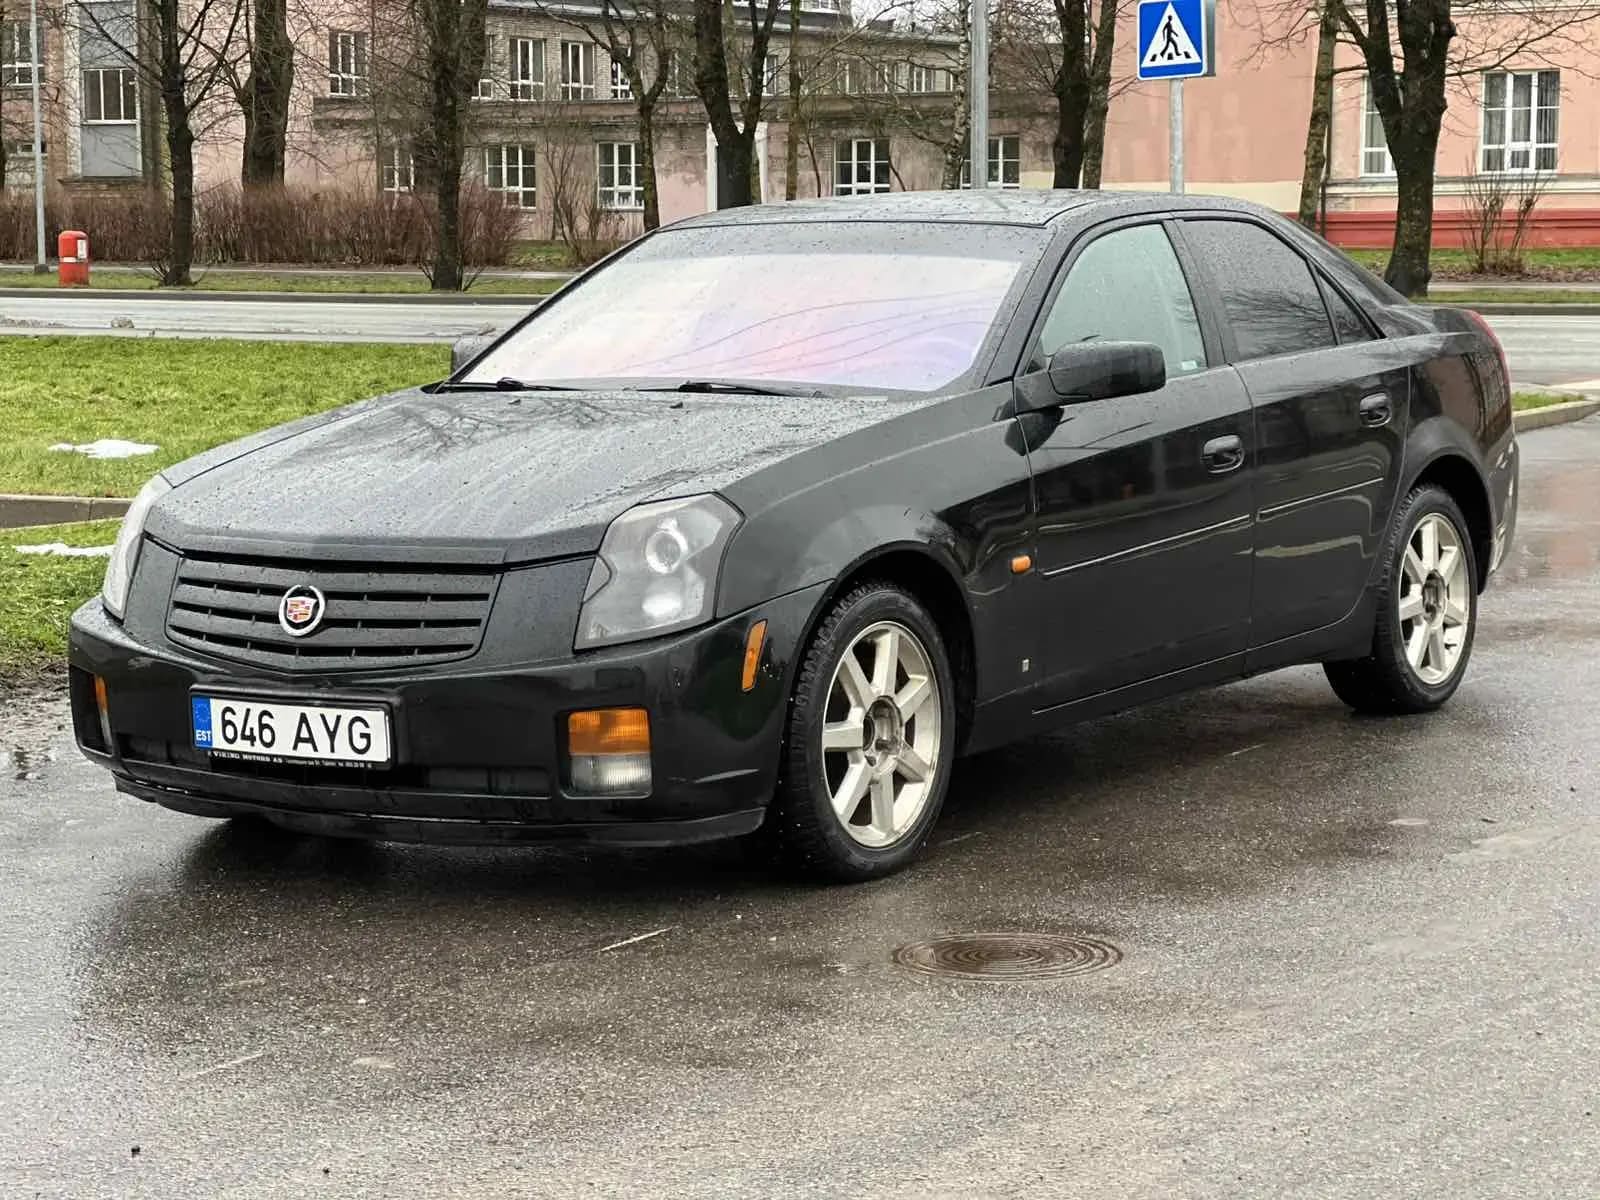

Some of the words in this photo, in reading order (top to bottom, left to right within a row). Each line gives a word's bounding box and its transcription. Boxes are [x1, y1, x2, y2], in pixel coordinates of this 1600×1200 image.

[195, 729, 211, 742] EST
[221, 706, 276, 749] 646
[292, 712, 372, 755] AYG
